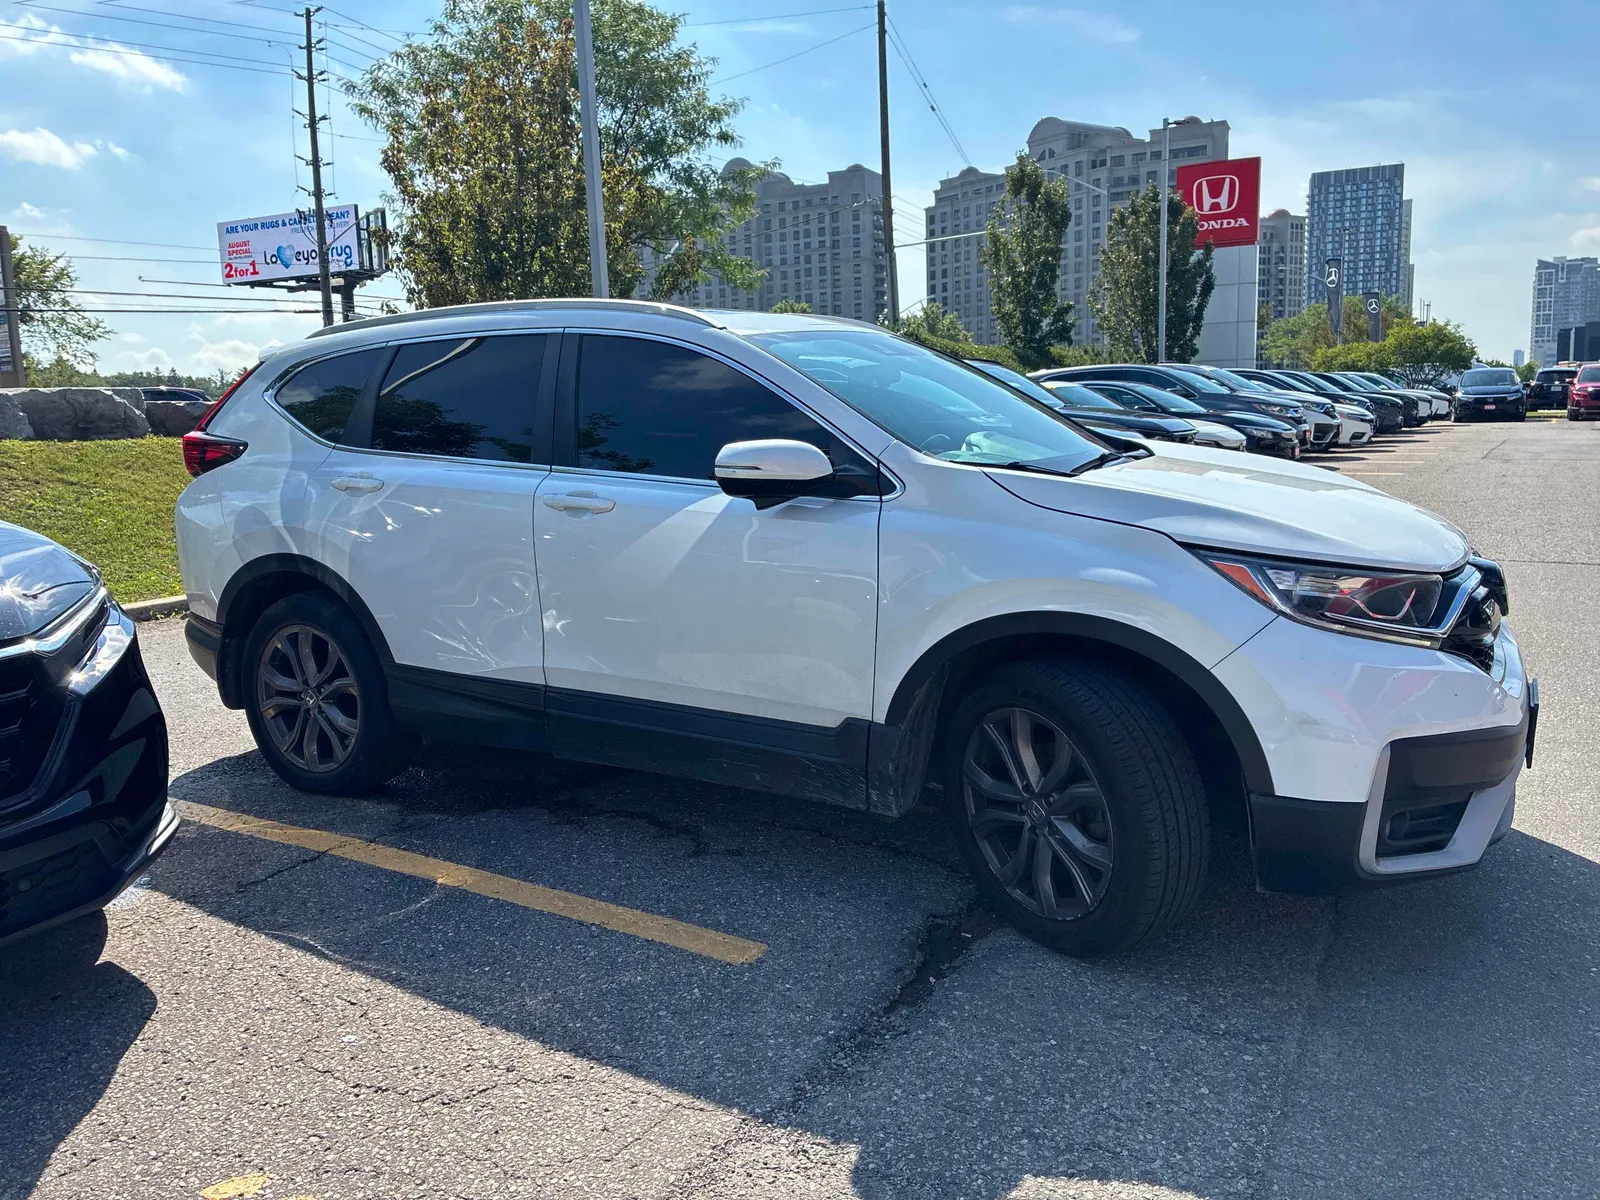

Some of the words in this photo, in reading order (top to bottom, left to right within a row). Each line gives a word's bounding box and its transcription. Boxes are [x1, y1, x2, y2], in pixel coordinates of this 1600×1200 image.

[225, 225, 239, 235] ARE
[240, 222, 259, 232] YOUR
[260, 220, 280, 230] RUGS
[281, 218, 287, 227] &
[329, 210, 350, 220] EAN?
[1198, 217, 1250, 230] ONDA
[228, 240, 250, 249] AUGUST
[228, 248, 252, 257] SPECIAL
